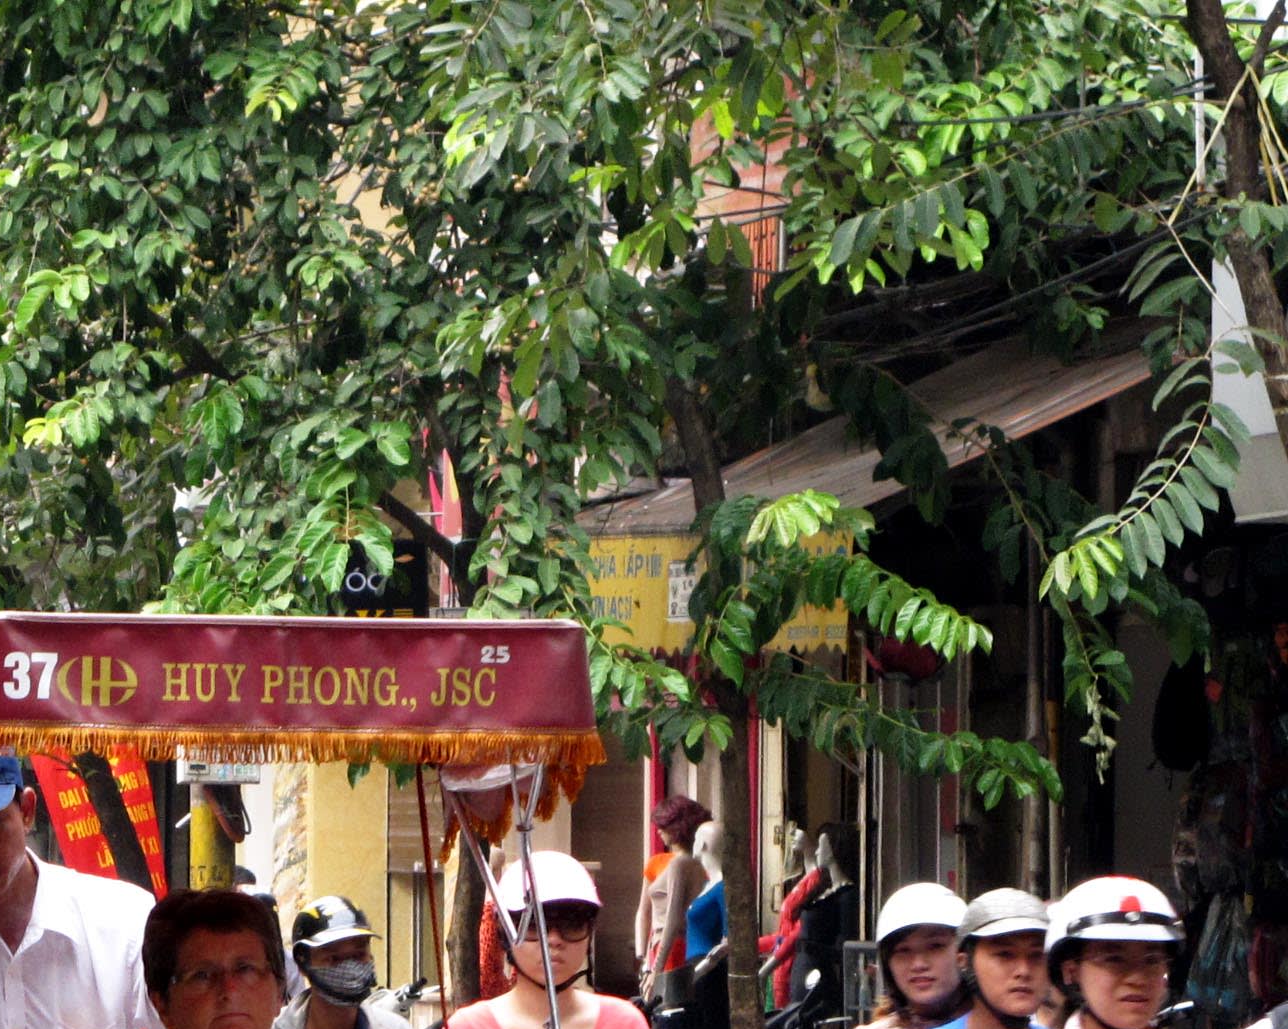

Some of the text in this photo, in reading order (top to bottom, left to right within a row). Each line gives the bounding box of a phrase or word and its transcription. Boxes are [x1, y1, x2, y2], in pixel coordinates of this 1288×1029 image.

[2, 652, 59, 700] 37
[479, 644, 511, 664] 25
[161, 663, 247, 702] HUY
[431, 666, 497, 707] JSC
